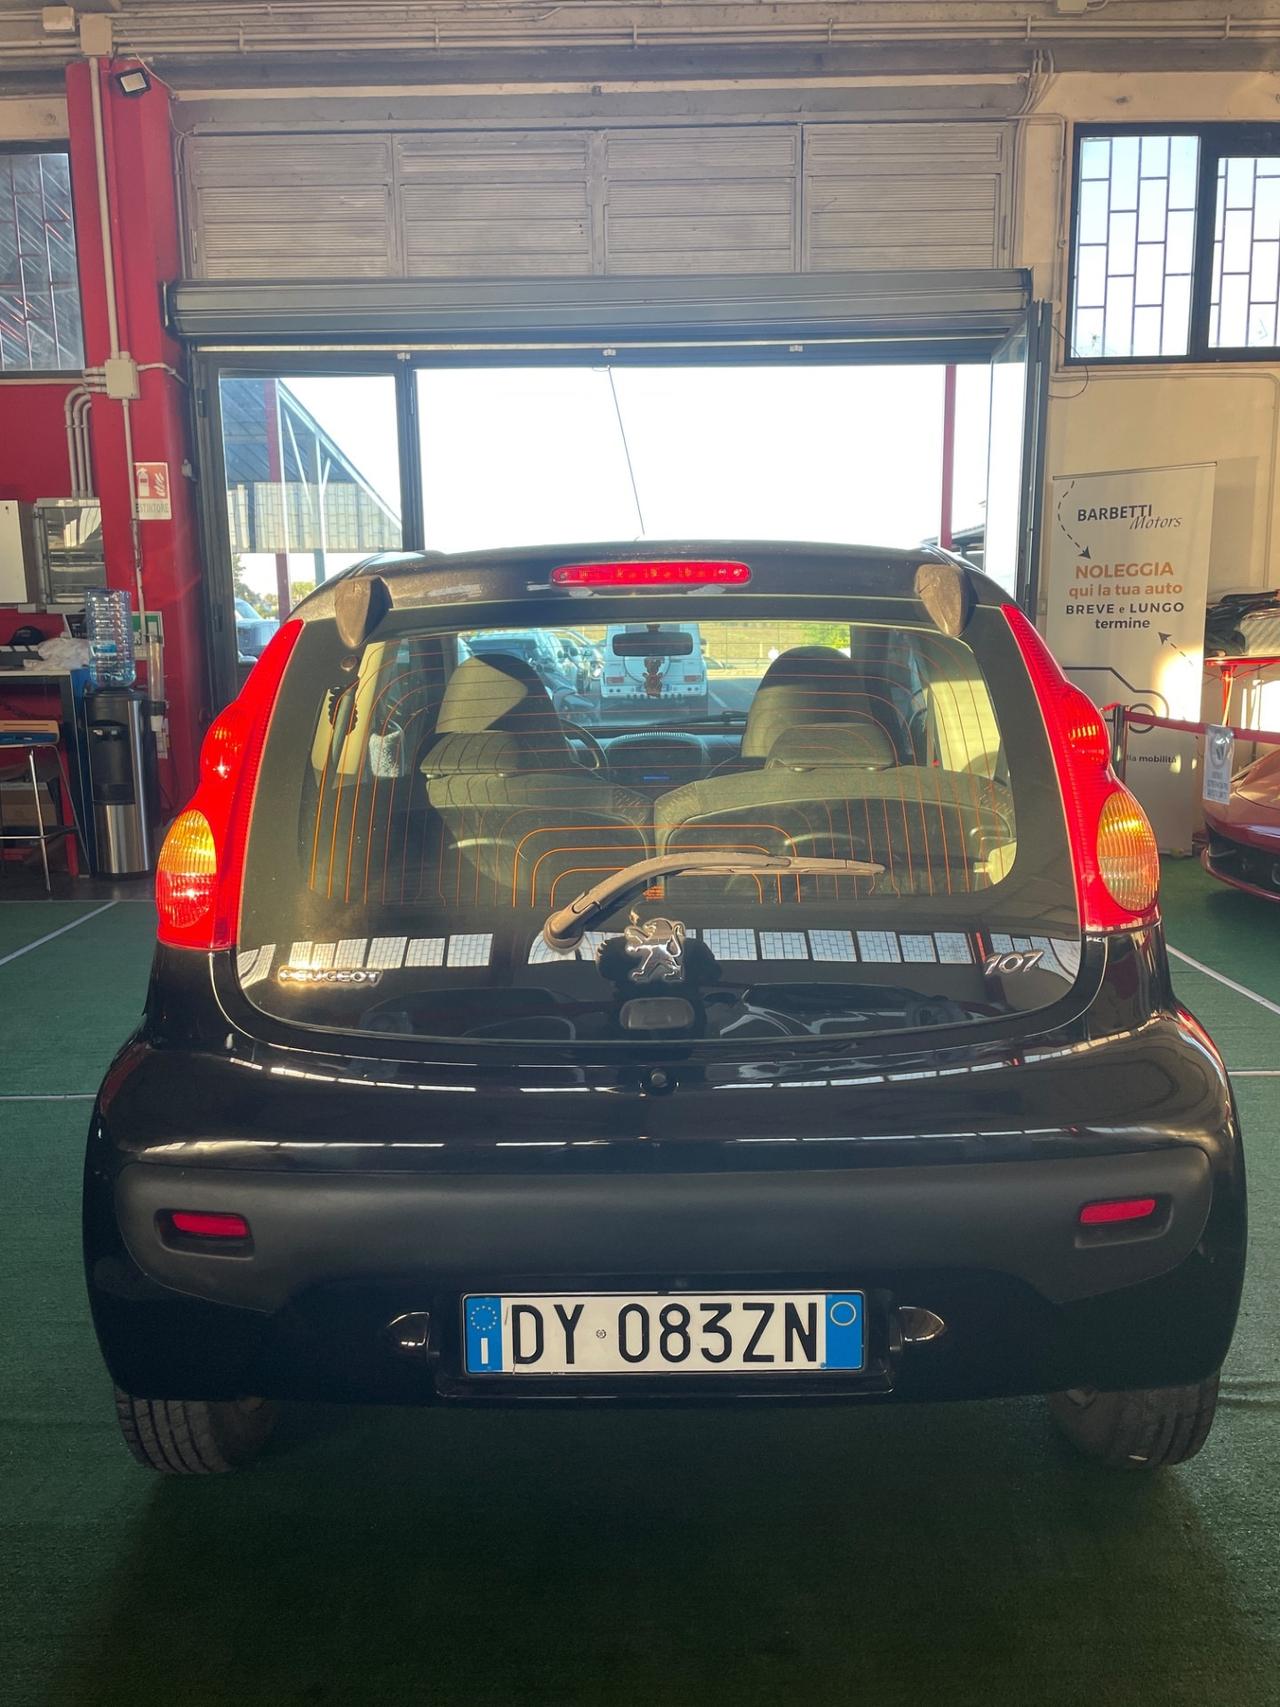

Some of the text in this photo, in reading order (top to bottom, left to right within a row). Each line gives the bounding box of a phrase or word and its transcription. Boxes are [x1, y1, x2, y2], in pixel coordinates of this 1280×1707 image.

[1077, 504, 1152, 521] BARBETTI
[1129, 515, 1182, 530] Motors
[1075, 562, 1174, 579] NOLEGGIA
[1068, 582, 1183, 600] qui la tua auto
[1066, 603, 1115, 615] BREVE
[1129, 602, 1184, 613] LUNGO
[1095, 617, 1150, 629] termine
[985, 950, 1043, 975] 107
[512, 1302, 818, 1365] DY 083ZN
